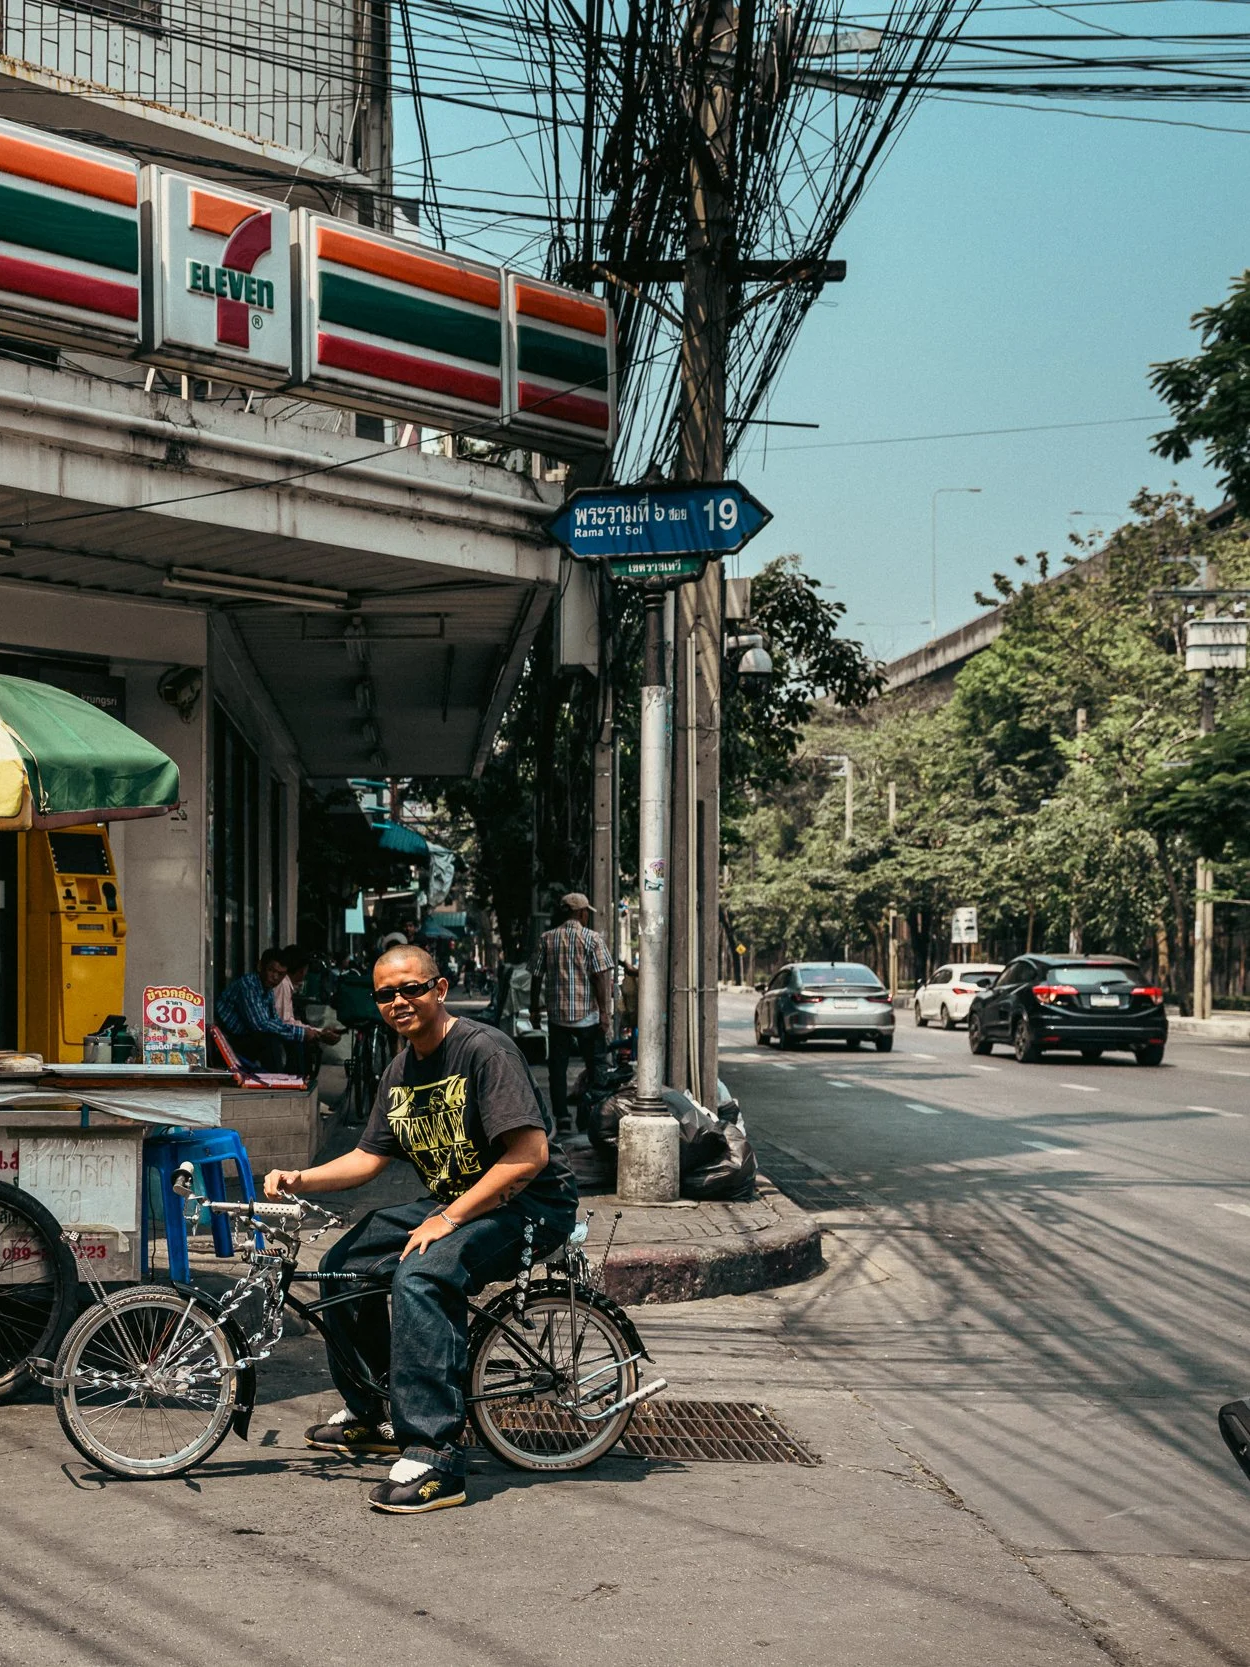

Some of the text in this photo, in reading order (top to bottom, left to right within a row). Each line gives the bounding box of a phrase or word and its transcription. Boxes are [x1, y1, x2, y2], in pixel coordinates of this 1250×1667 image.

[574, 493, 649, 526] พระรามที่
[668, 508, 687, 521] ซอย
[703, 498, 738, 532] 19
[574, 526, 643, 538] Rama VI Soi
[146, 988, 202, 1005] ข้าวกล่อง
